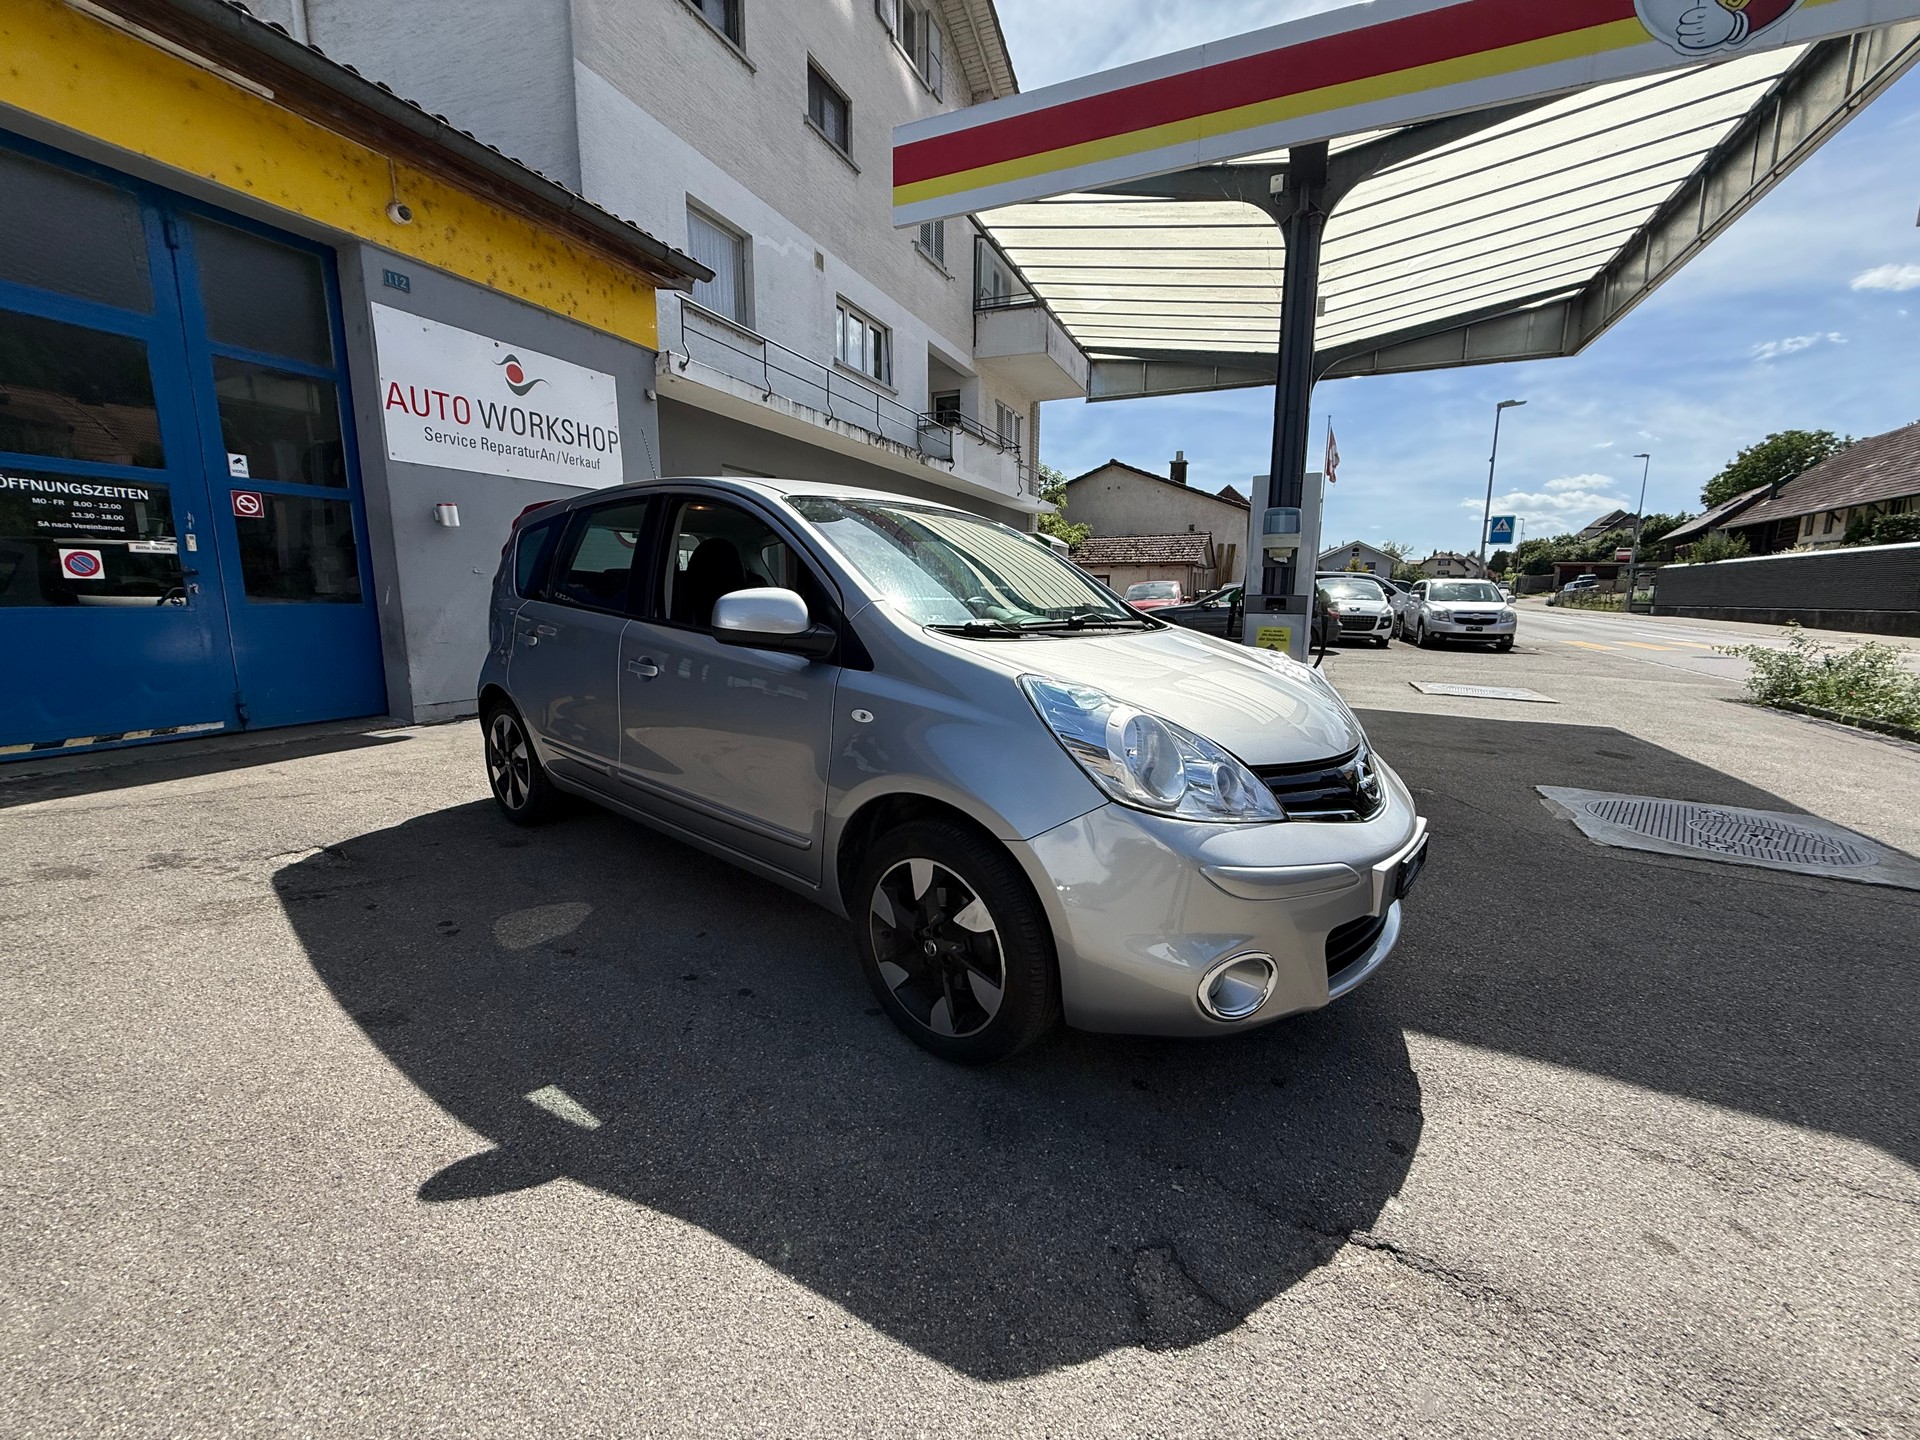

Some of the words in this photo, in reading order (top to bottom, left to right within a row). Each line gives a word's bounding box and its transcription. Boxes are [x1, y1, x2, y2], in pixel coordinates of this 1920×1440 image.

[388, 272, 407, 289] 112
[386, 381, 471, 425] AUTO
[477, 399, 618, 453] WORKSHOP
[424, 426, 477, 449] Service
[32, 497, 47, 505] MO
[37, 520, 50, 528] SA
[51, 521, 72, 529] nach
